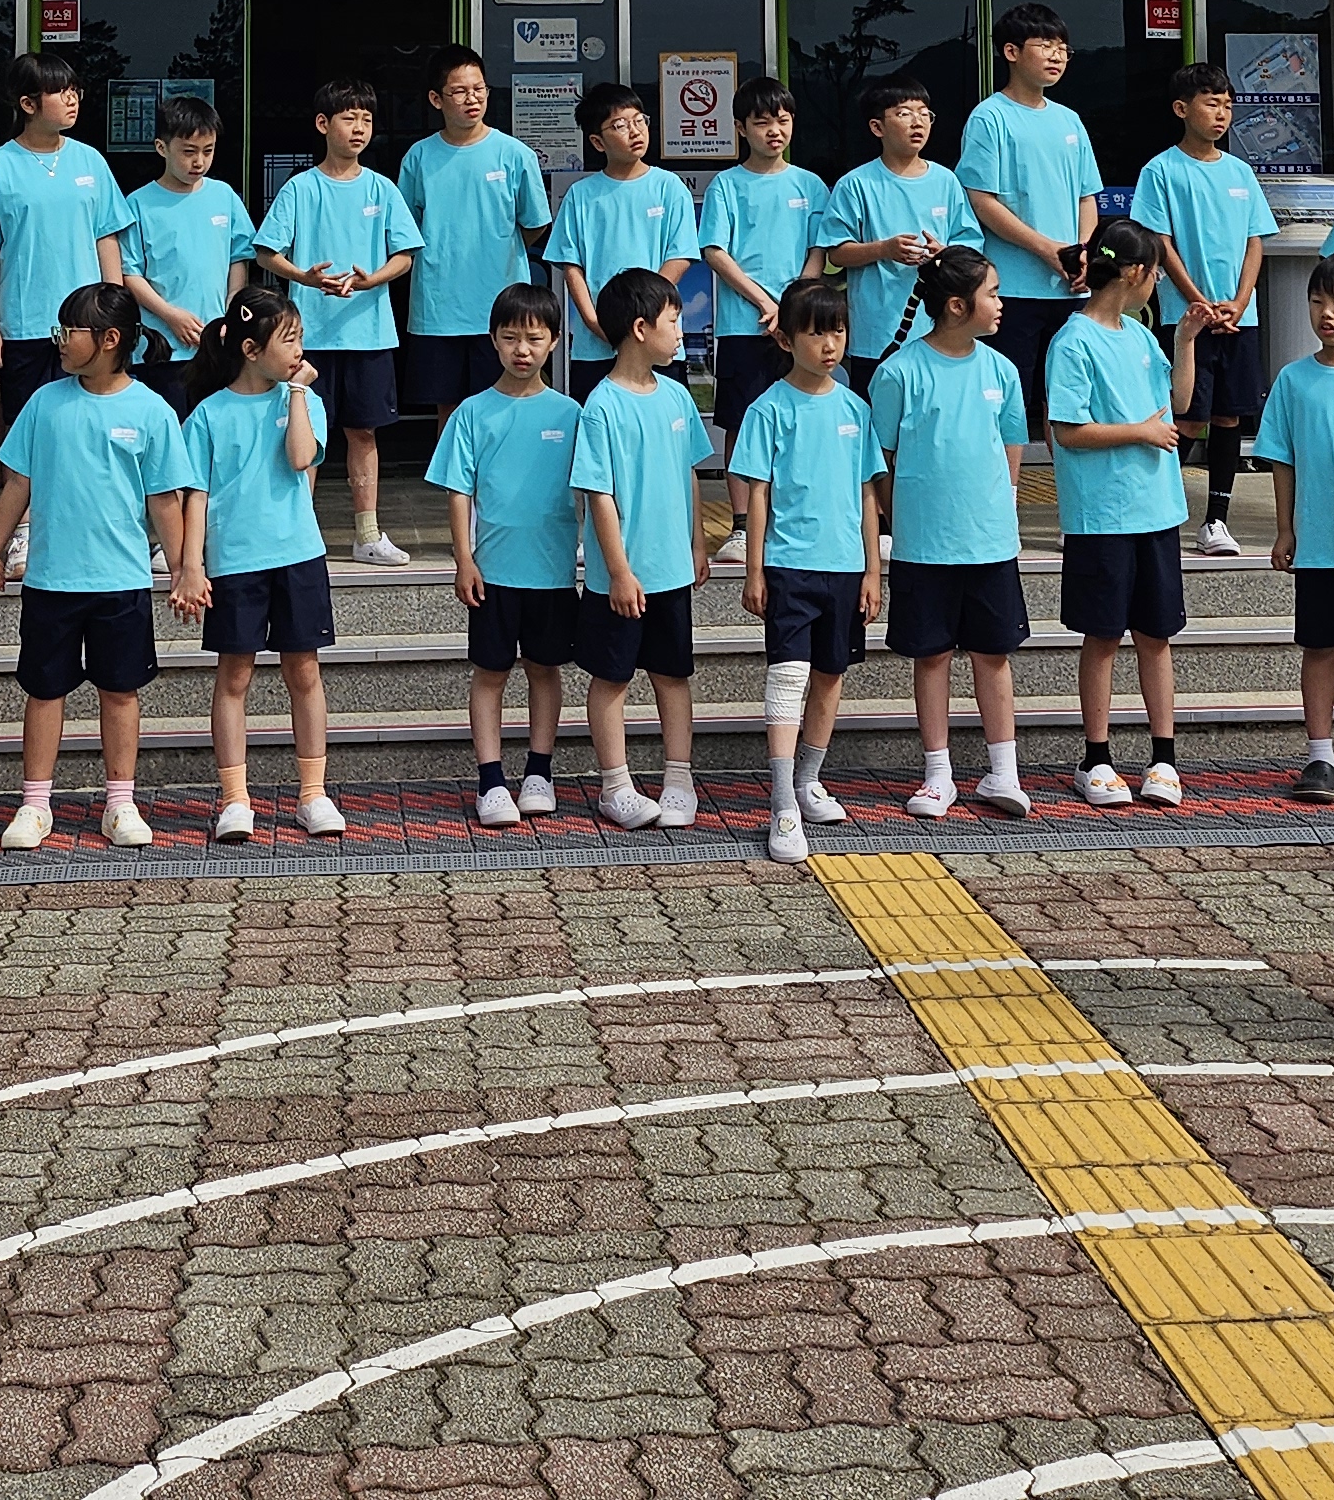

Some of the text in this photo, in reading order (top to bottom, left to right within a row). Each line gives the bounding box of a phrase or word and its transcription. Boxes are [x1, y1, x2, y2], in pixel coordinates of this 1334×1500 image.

[43, 9, 71, 20] 에스원
[1152, 7, 1179, 18] 에스원
[680, 119, 718, 136] 금연
